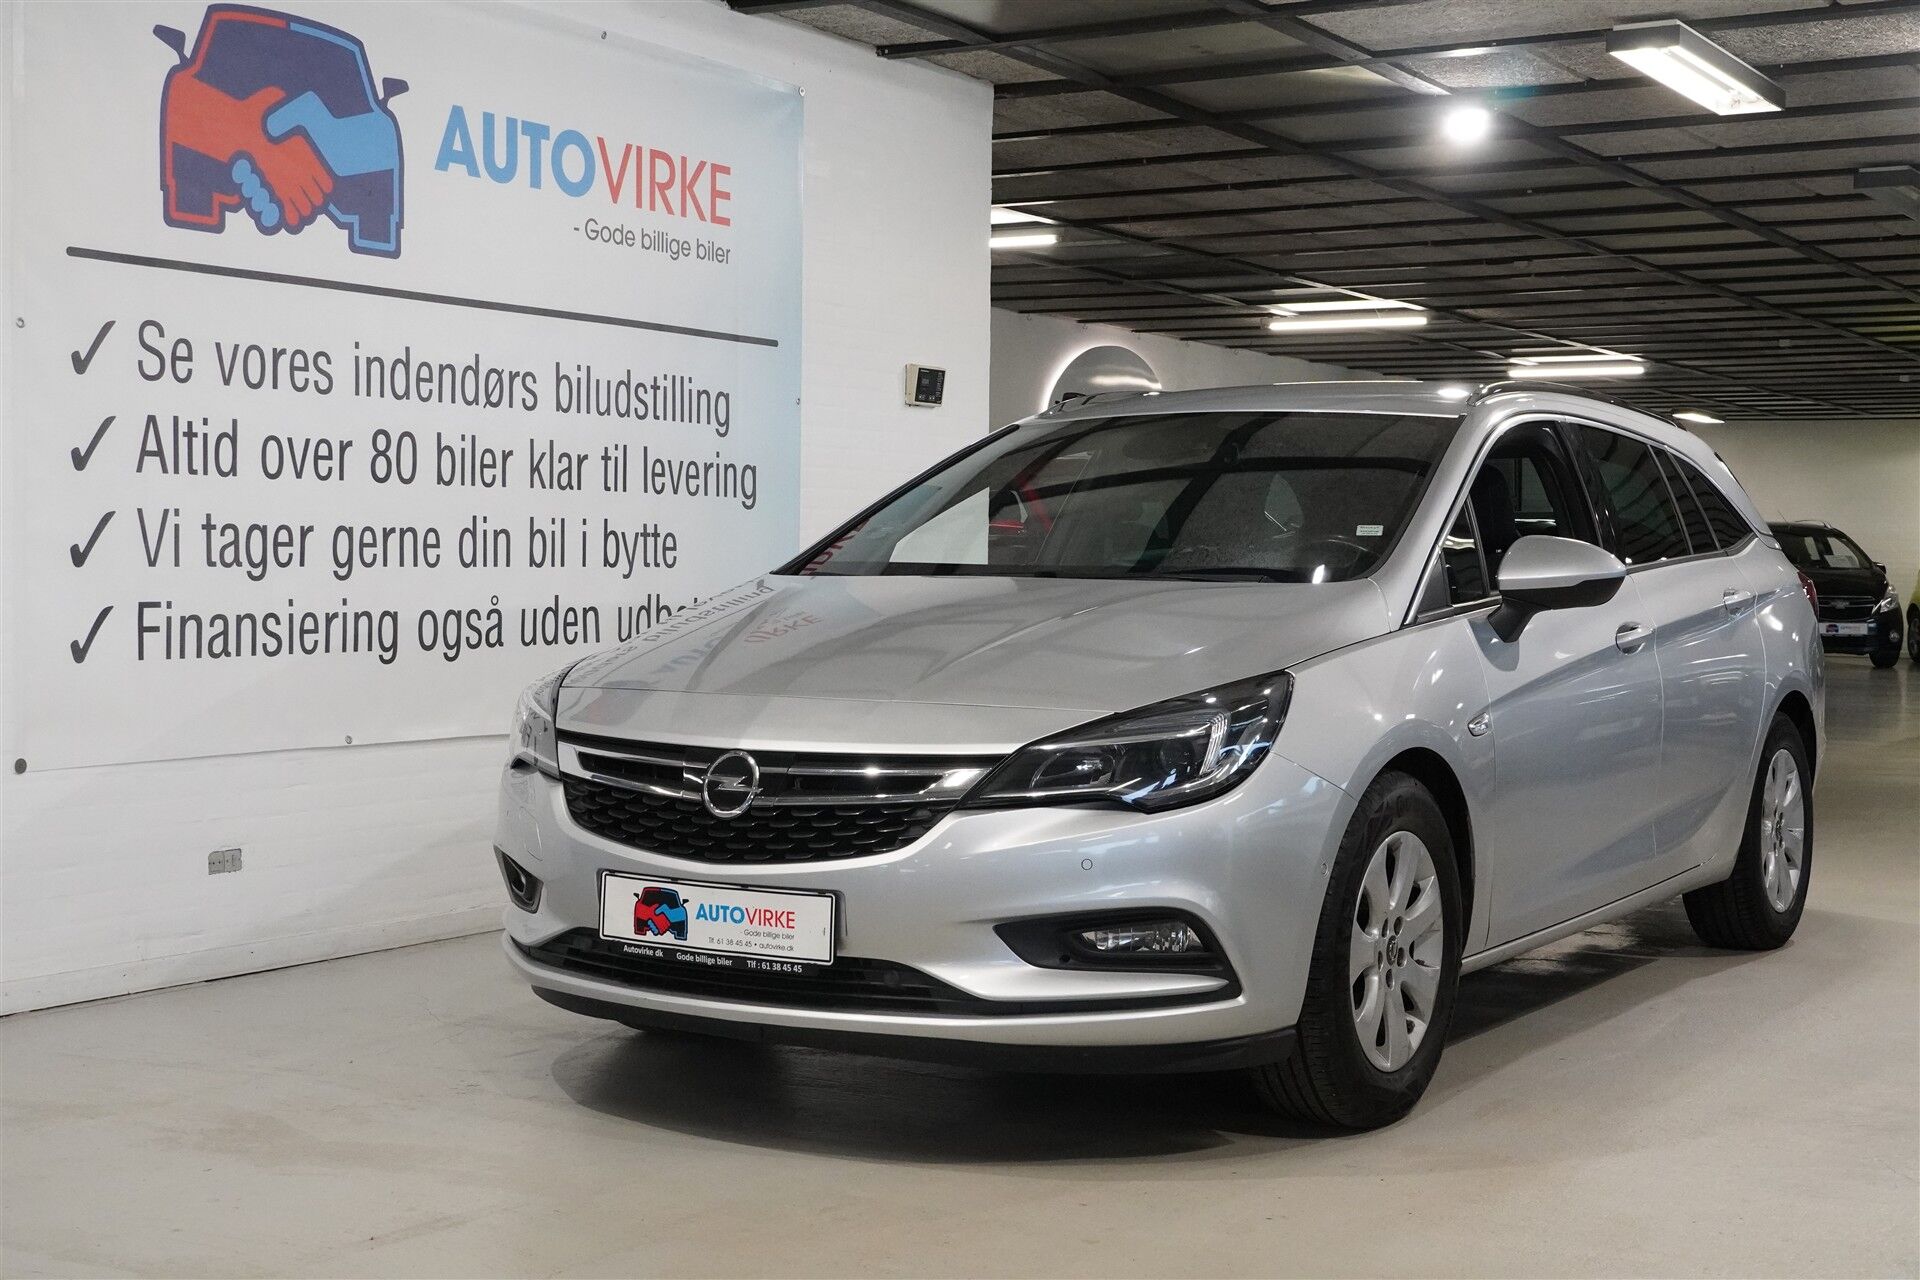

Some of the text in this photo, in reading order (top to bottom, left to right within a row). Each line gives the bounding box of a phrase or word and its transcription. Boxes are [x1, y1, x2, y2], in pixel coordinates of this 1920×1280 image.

[435, 105, 732, 227] AUTOVIRKE
[585, 219, 637, 248] Gode
[641, 227, 692, 261] billige
[696, 238, 731, 265] biler
[138, 320, 731, 438] Se vores indendørs biludstilling
[136, 414, 757, 511] Altid over 80 biler klar til levering
[136, 507, 678, 582] Vi tager gerne din bil i bytte
[137, 597, 399, 665] Finansiering
[417, 594, 505, 663] også
[520, 594, 601, 647] uden
[695, 903, 796, 929] AUTOVIRKE
[744, 929, 761, 937] Gode
[763, 930, 781, 940] billige
[782, 931, 795, 940] biler
[676, 952, 733, 966] Gode billige biler
[717, 937, 724, 945] 61
[726, 938, 734, 946] 38
[735, 939, 743, 947] 45
[745, 940, 753, 948] 45
[761, 961, 771, 970] 61
[772, 962, 781, 971] 38
[782, 963, 792, 972] 45
[793, 964, 803, 973] 45
